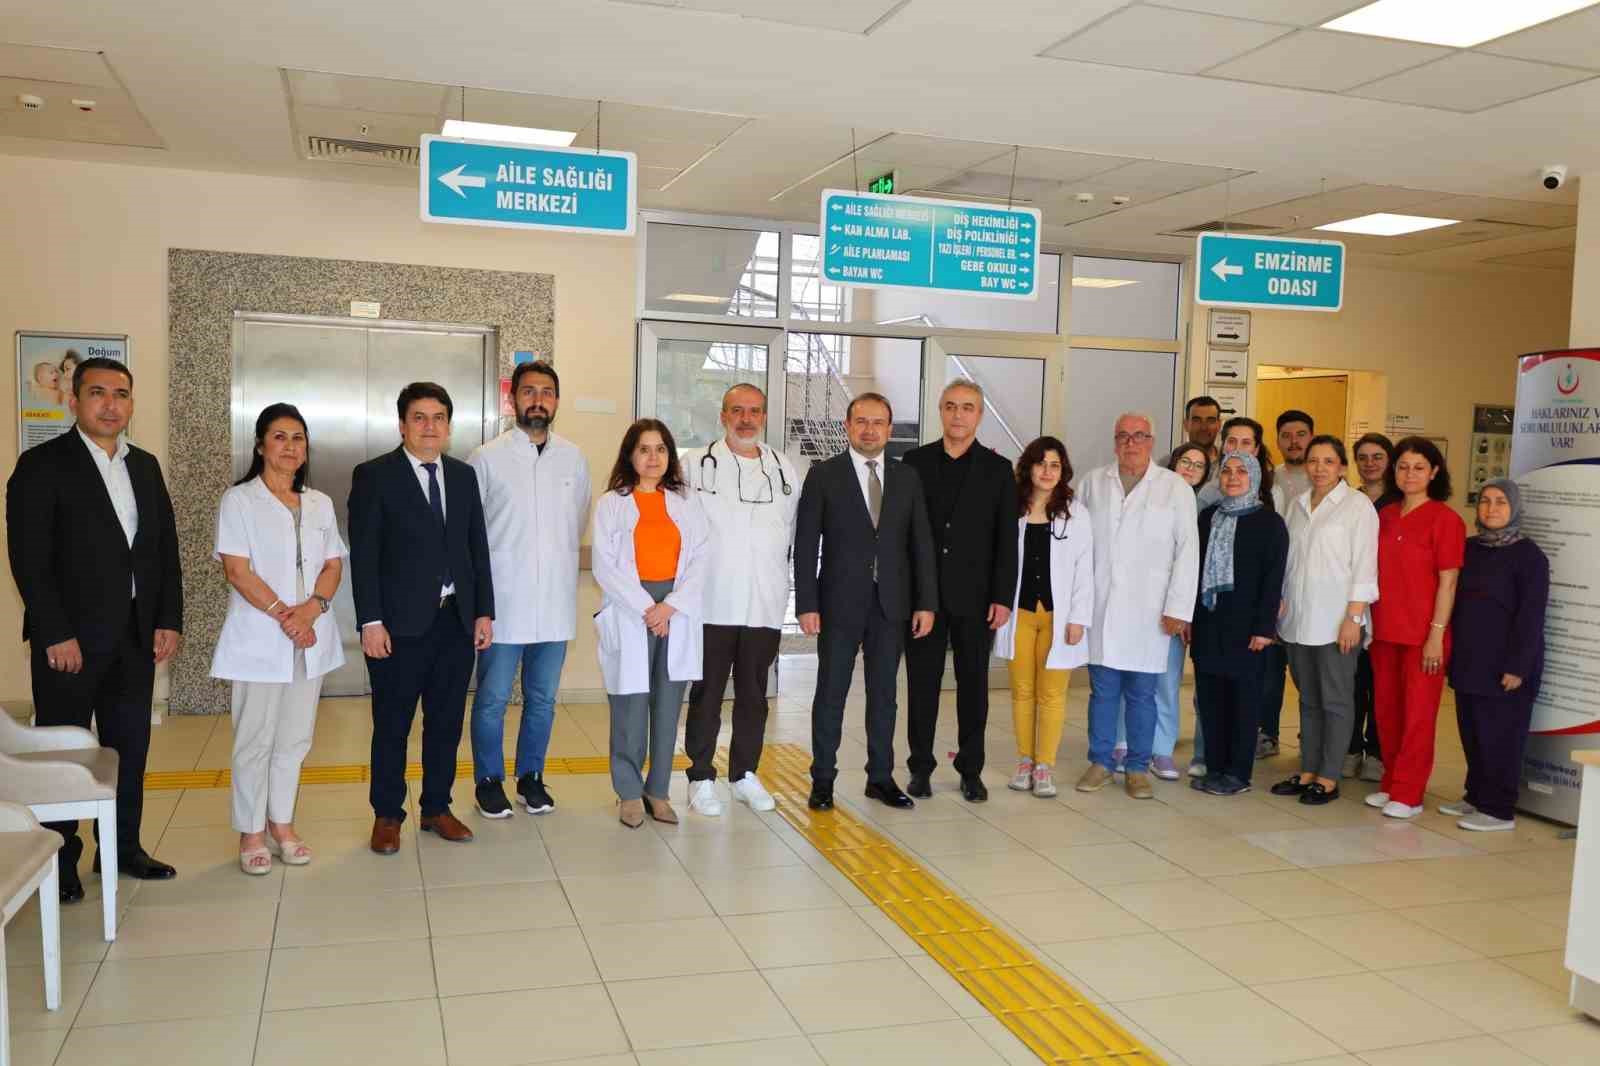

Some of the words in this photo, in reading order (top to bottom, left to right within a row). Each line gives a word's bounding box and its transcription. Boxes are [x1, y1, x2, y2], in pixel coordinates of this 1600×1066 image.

[496, 161, 536, 184] AİLE
[542, 165, 613, 191] SAĞLIĞI
[496, 190, 577, 214] MERKEZİ
[845, 201, 862, 216] AİLE
[954, 211, 969, 228] DİŞ
[972, 215, 1018, 230] HEKİMLİĞİ
[845, 224, 862, 236] KAN
[865, 225, 889, 239] ALMA
[892, 228, 911, 240] LAB.
[947, 226, 962, 242] DİŞ
[965, 229, 1018, 245] POLİKLİNİĞİ
[844, 244, 861, 258] AİLE
[862, 248, 910, 262] PLANLAMASI
[961, 260, 985, 272] GEBE
[987, 262, 1017, 274] OKULU
[1254, 250, 1333, 273] EMZİRME
[843, 265, 869, 278] BAYAN
[870, 267, 883, 279] WC
[980, 276, 999, 288] BAY
[1000, 278, 1016, 289] WC
[1267, 277, 1318, 297] ODASI
[88, 346, 120, 358] Doğum
[1531, 407, 1590, 418] HAKLARINIZ
[1551, 437, 1574, 448] VAR!
